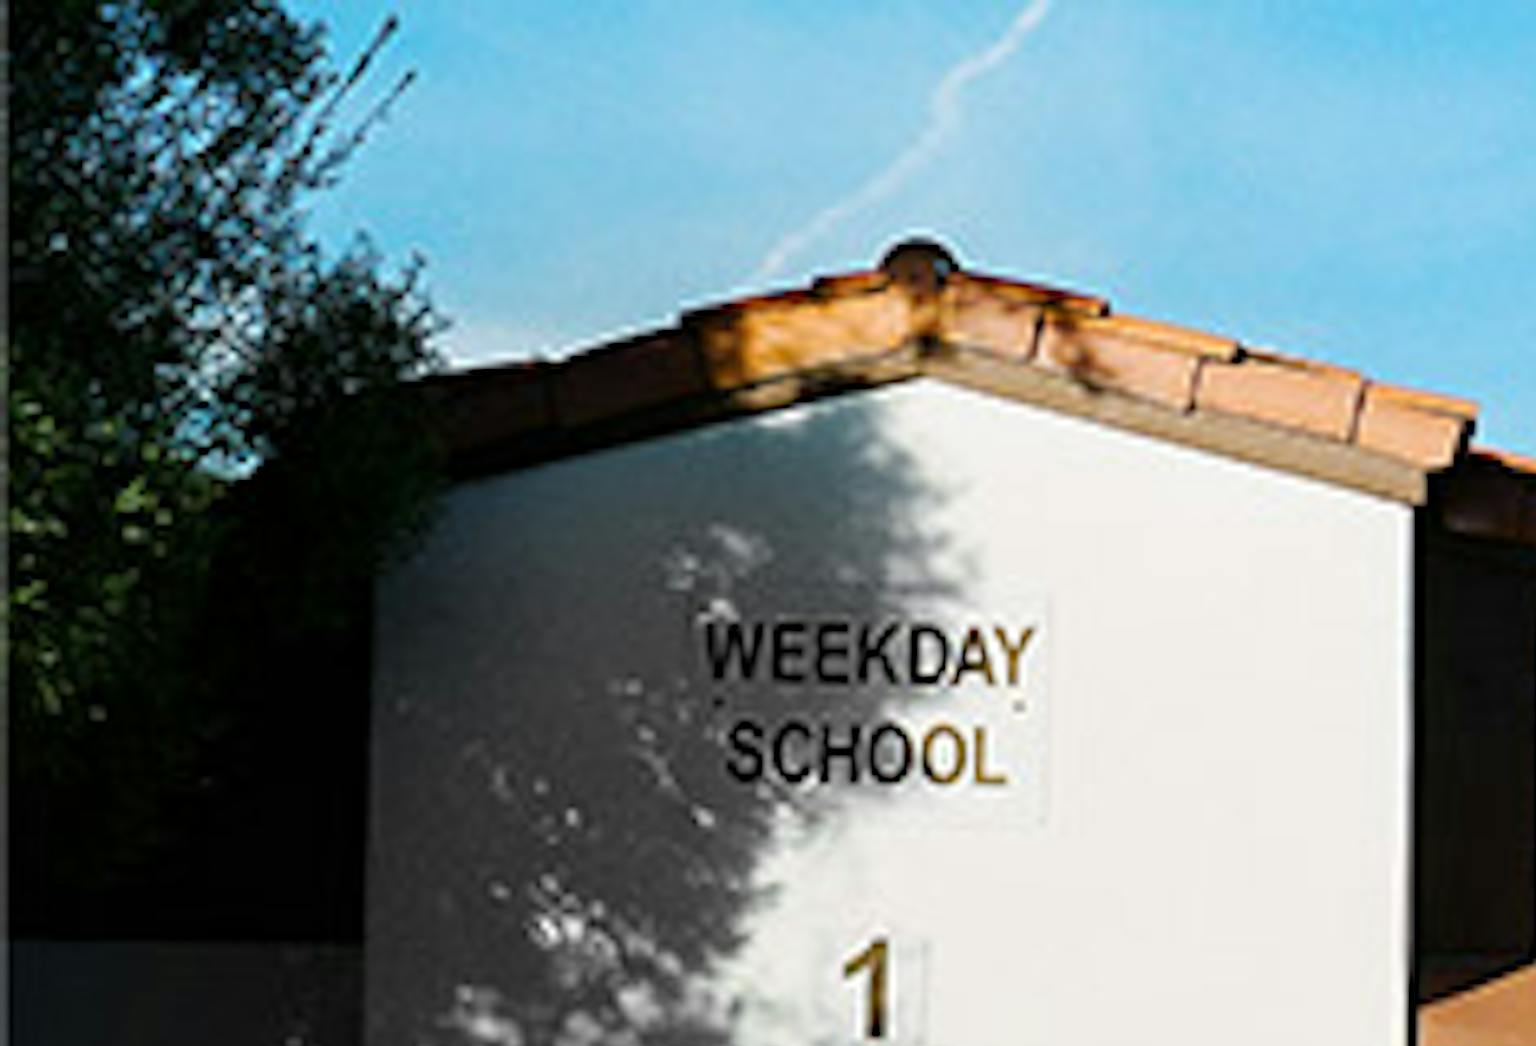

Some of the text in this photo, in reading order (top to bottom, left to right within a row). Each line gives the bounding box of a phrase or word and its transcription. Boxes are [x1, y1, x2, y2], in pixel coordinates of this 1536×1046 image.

[705, 622, 1034, 686] WEEKDAY
[726, 721, 1007, 785] SCHOOL
[842, 937, 889, 1039] 1
